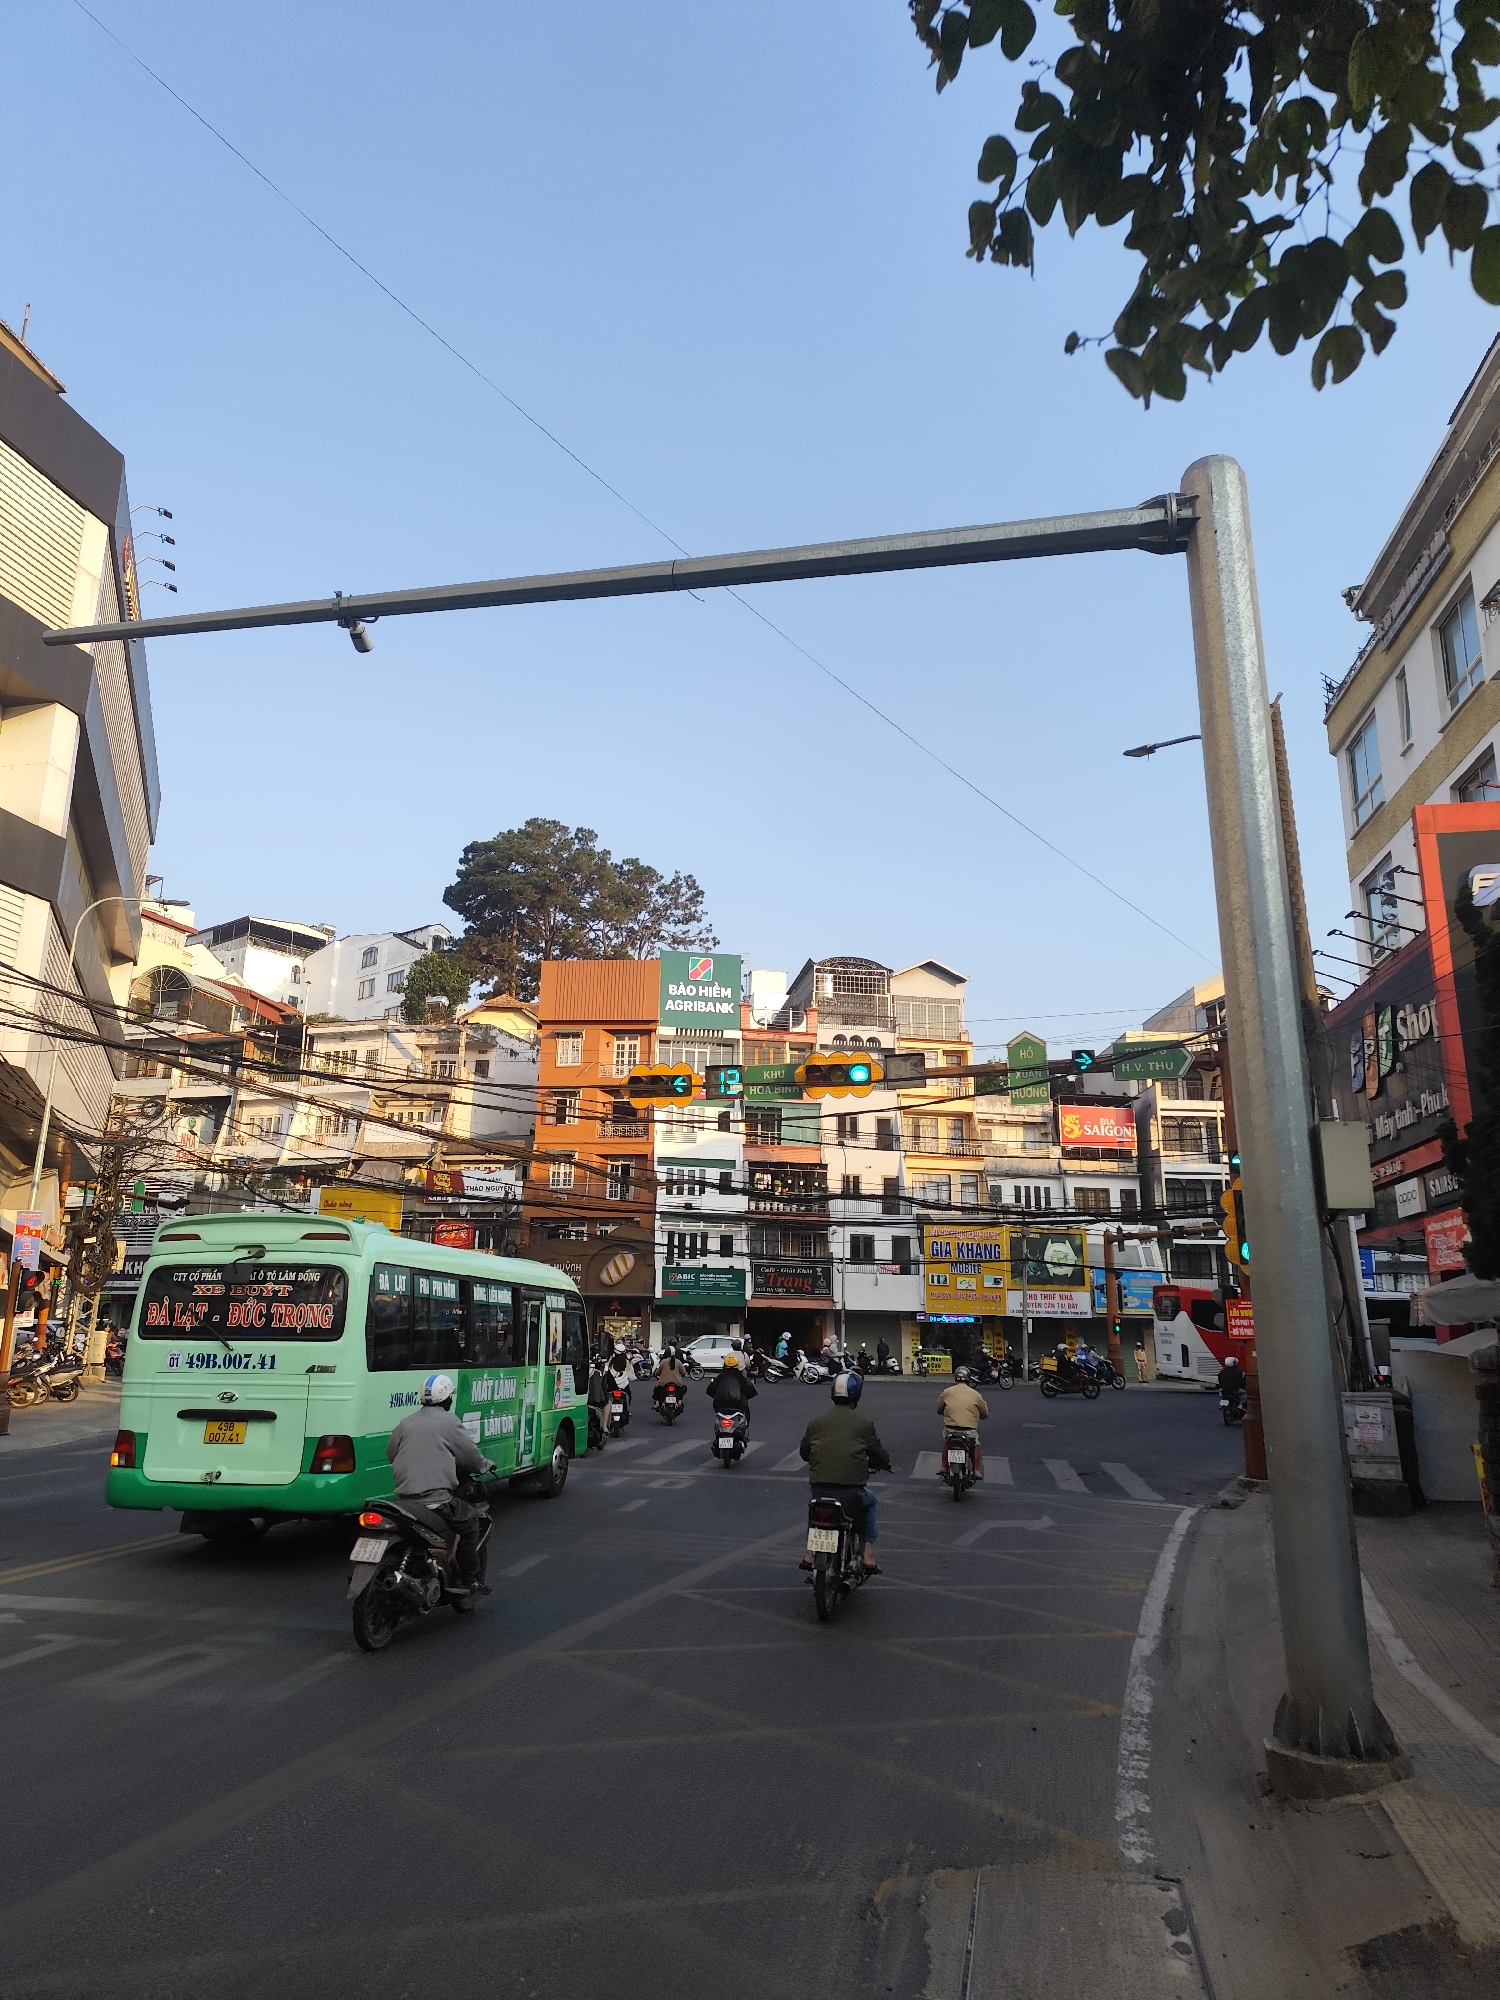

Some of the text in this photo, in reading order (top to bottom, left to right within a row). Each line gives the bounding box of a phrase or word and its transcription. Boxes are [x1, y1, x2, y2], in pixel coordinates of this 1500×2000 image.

[668, 981, 732, 999] BẢO HIỂM
[665, 999, 735, 1014] AGRIBANK
[1121, 1061, 1174, 1073] H.V. THỤ
[763, 1070, 785, 1080] KHU
[1100, 1117, 1116, 1126] BIA
[1083, 1125, 1133, 1137] SAIGON
[931, 1240, 1001, 1260] GIA KHANG
[173, 1271, 188, 1282] CTY
[278, 1268, 296, 1281] LÂM
[950, 1262, 982, 1275] MOBILE
[378, 1270, 390, 1291] ĐÀ
[394, 1274, 407, 1295] LẠT
[767, 1272, 813, 1292] Trang
[192, 1282, 294, 1297] XE BUÝT
[1026, 1293, 1038, 1301] HO
[146, 1296, 170, 1326] ĐÀ
[172, 1302, 209, 1331] LẠT
[227, 1297, 266, 1328] ĐỨC
[271, 1303, 335, 1333] TRỌNG
[1240, 1308, 1253, 1318] VƯỢ
[168, 1352, 277, 1370] 01 49B.007.41
[470, 1370, 517, 1405] MÁT LÀNH
[217, 1422, 235, 1432] 49B
[208, 1432, 240, 1443] 007.41
